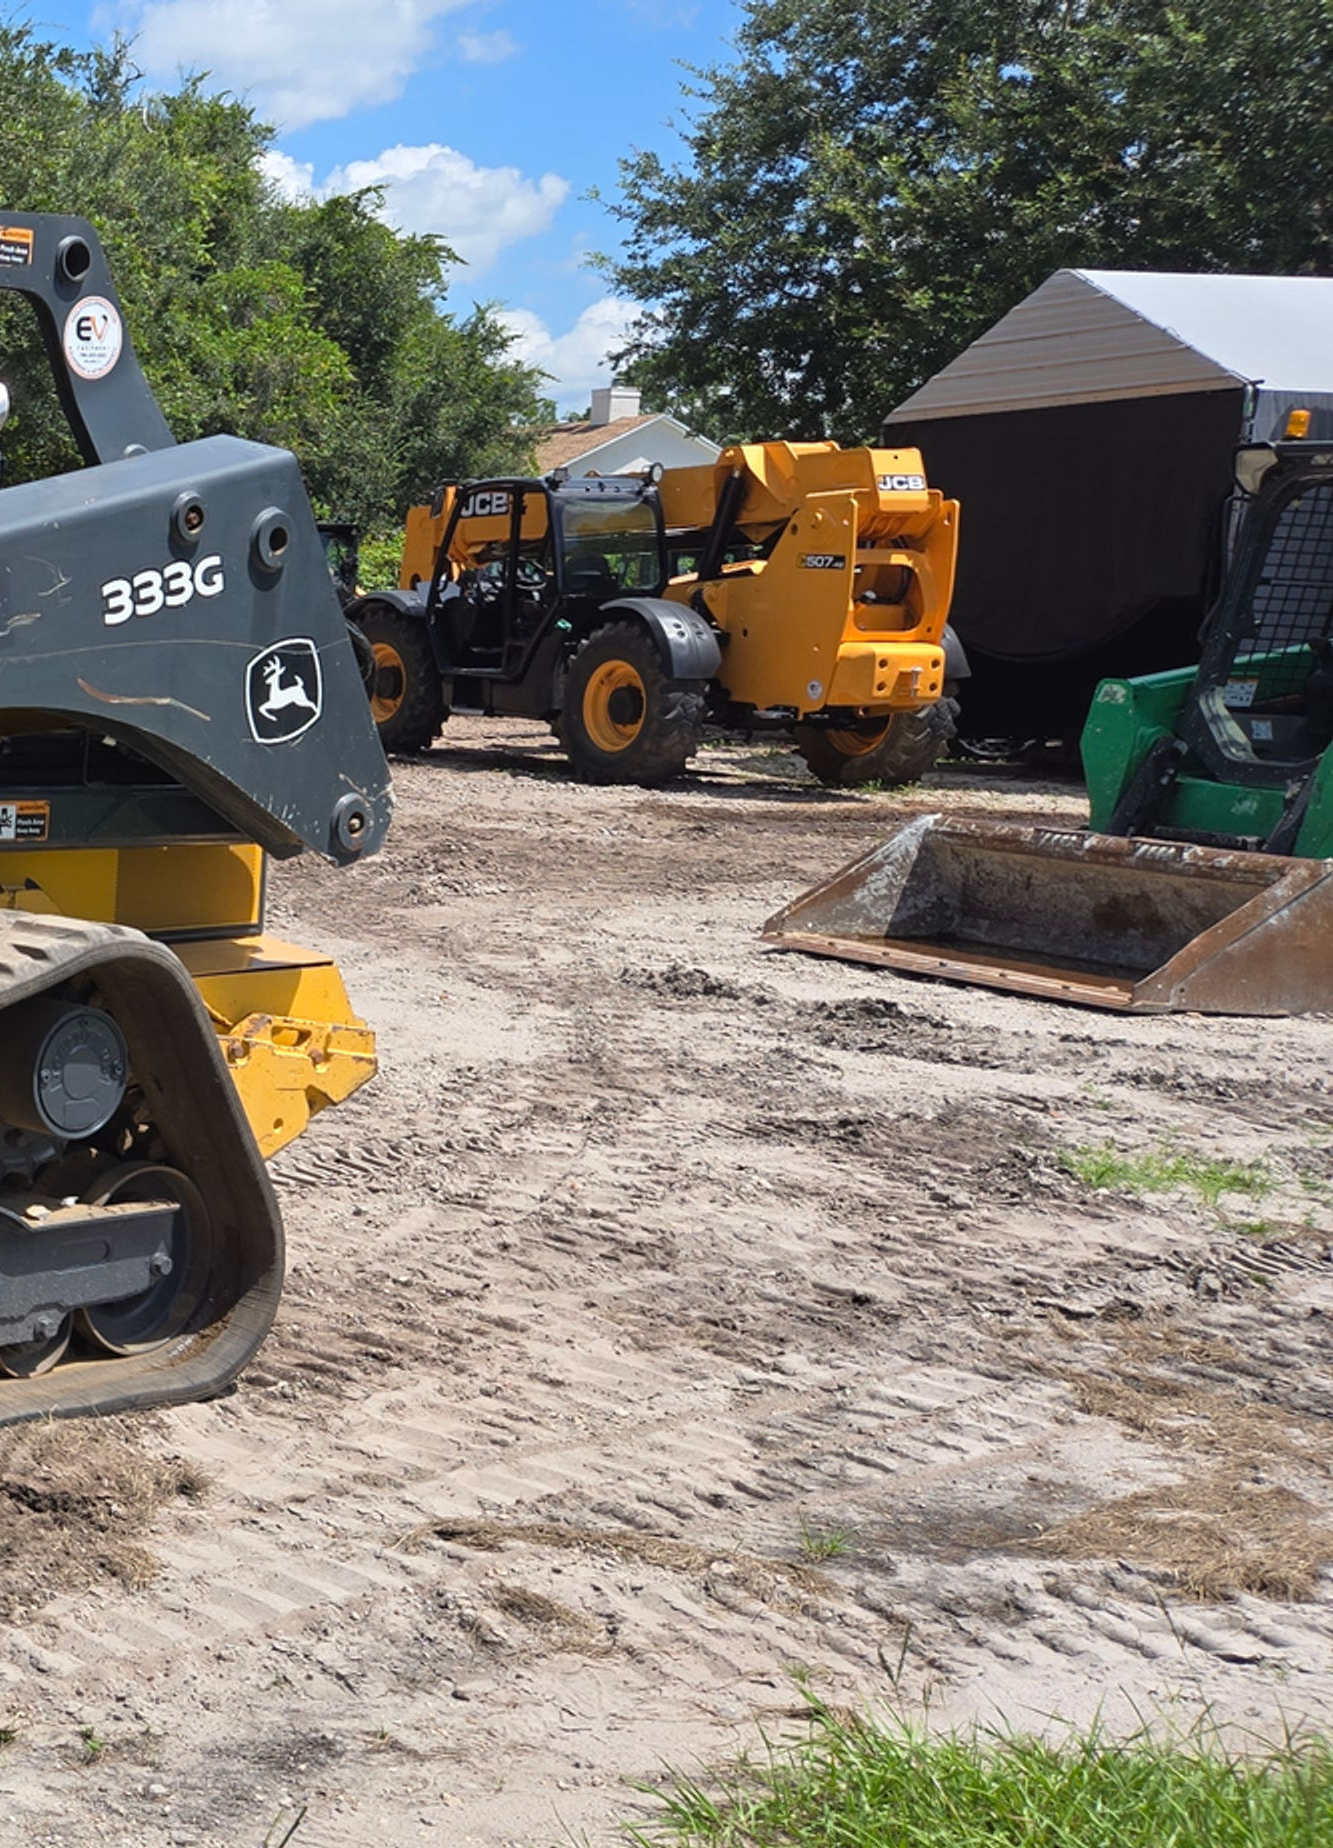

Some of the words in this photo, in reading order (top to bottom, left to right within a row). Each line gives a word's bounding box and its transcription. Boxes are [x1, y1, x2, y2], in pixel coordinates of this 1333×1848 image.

[878, 475, 925, 490] JCB
[461, 492, 509, 517] JCB
[101, 555, 224, 625] 333G
